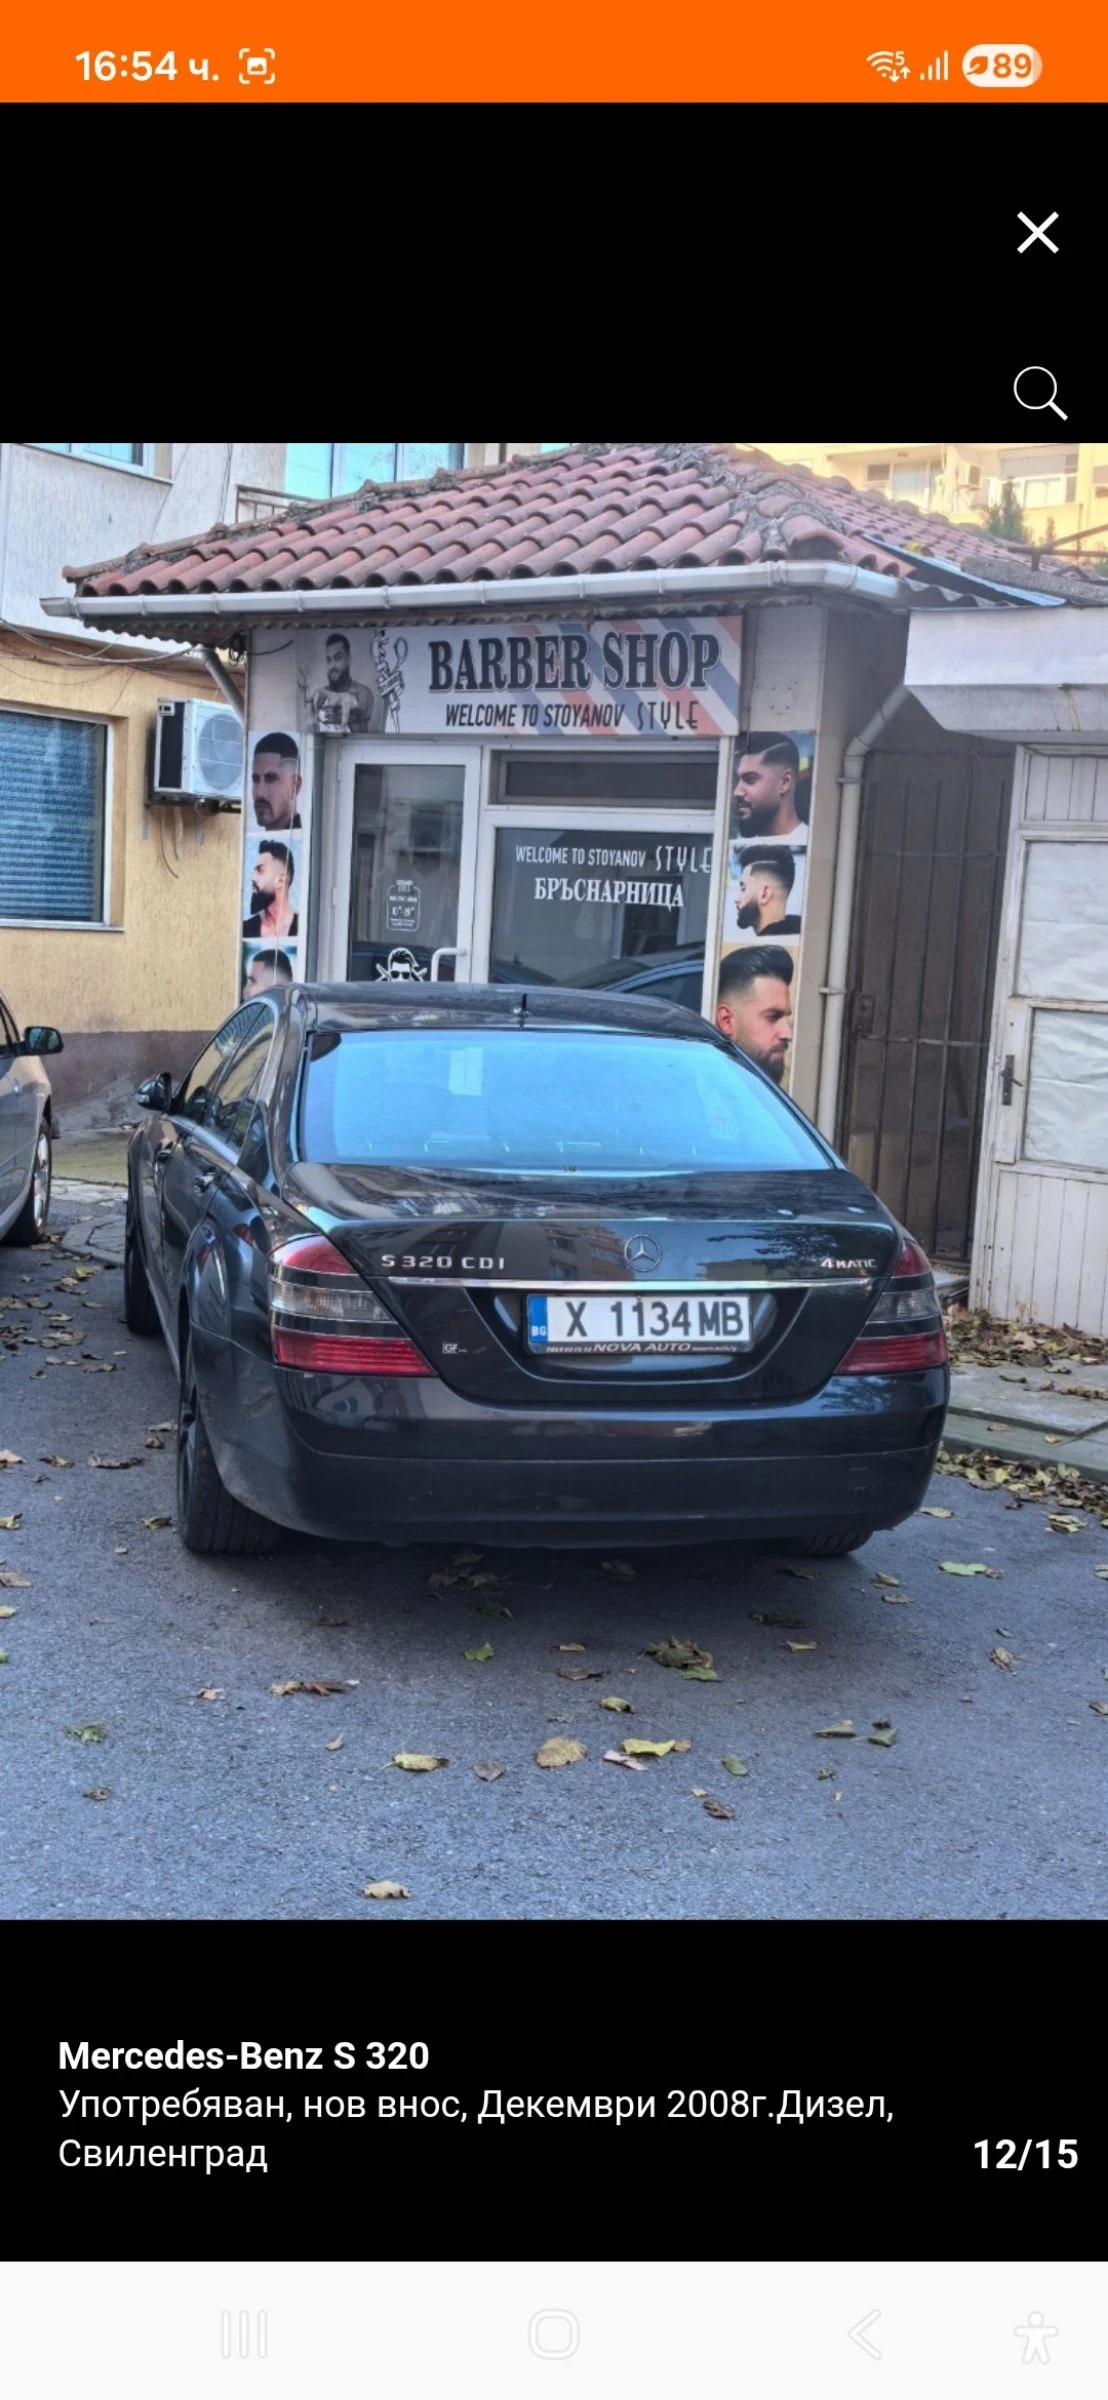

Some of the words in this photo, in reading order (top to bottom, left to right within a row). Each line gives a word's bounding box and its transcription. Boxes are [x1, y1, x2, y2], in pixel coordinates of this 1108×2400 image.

[428, 634, 592, 693] BARBER
[602, 630, 720, 690] SHOP
[446, 702, 517, 727] WELCOME
[521, 702, 539, 727] TO
[543, 703, 625, 727] STOYANOV
[636, 700, 699, 730] STYLE
[515, 845, 568, 864] WELCOME
[571, 848, 585, 865] TO
[588, 848, 647, 868] STOYANOV
[655, 845, 712, 874] STYLE
[534, 876, 685, 913] БРЪСНАРНИЦА
[381, 1254, 396, 1268] S
[401, 1255, 453, 1269] 320
[461, 1256, 505, 1270] CDI
[531, 1325, 547, 1337] BG
[593, 1342, 641, 1353] NOVA
[644, 1342, 691, 1353] AUTO
